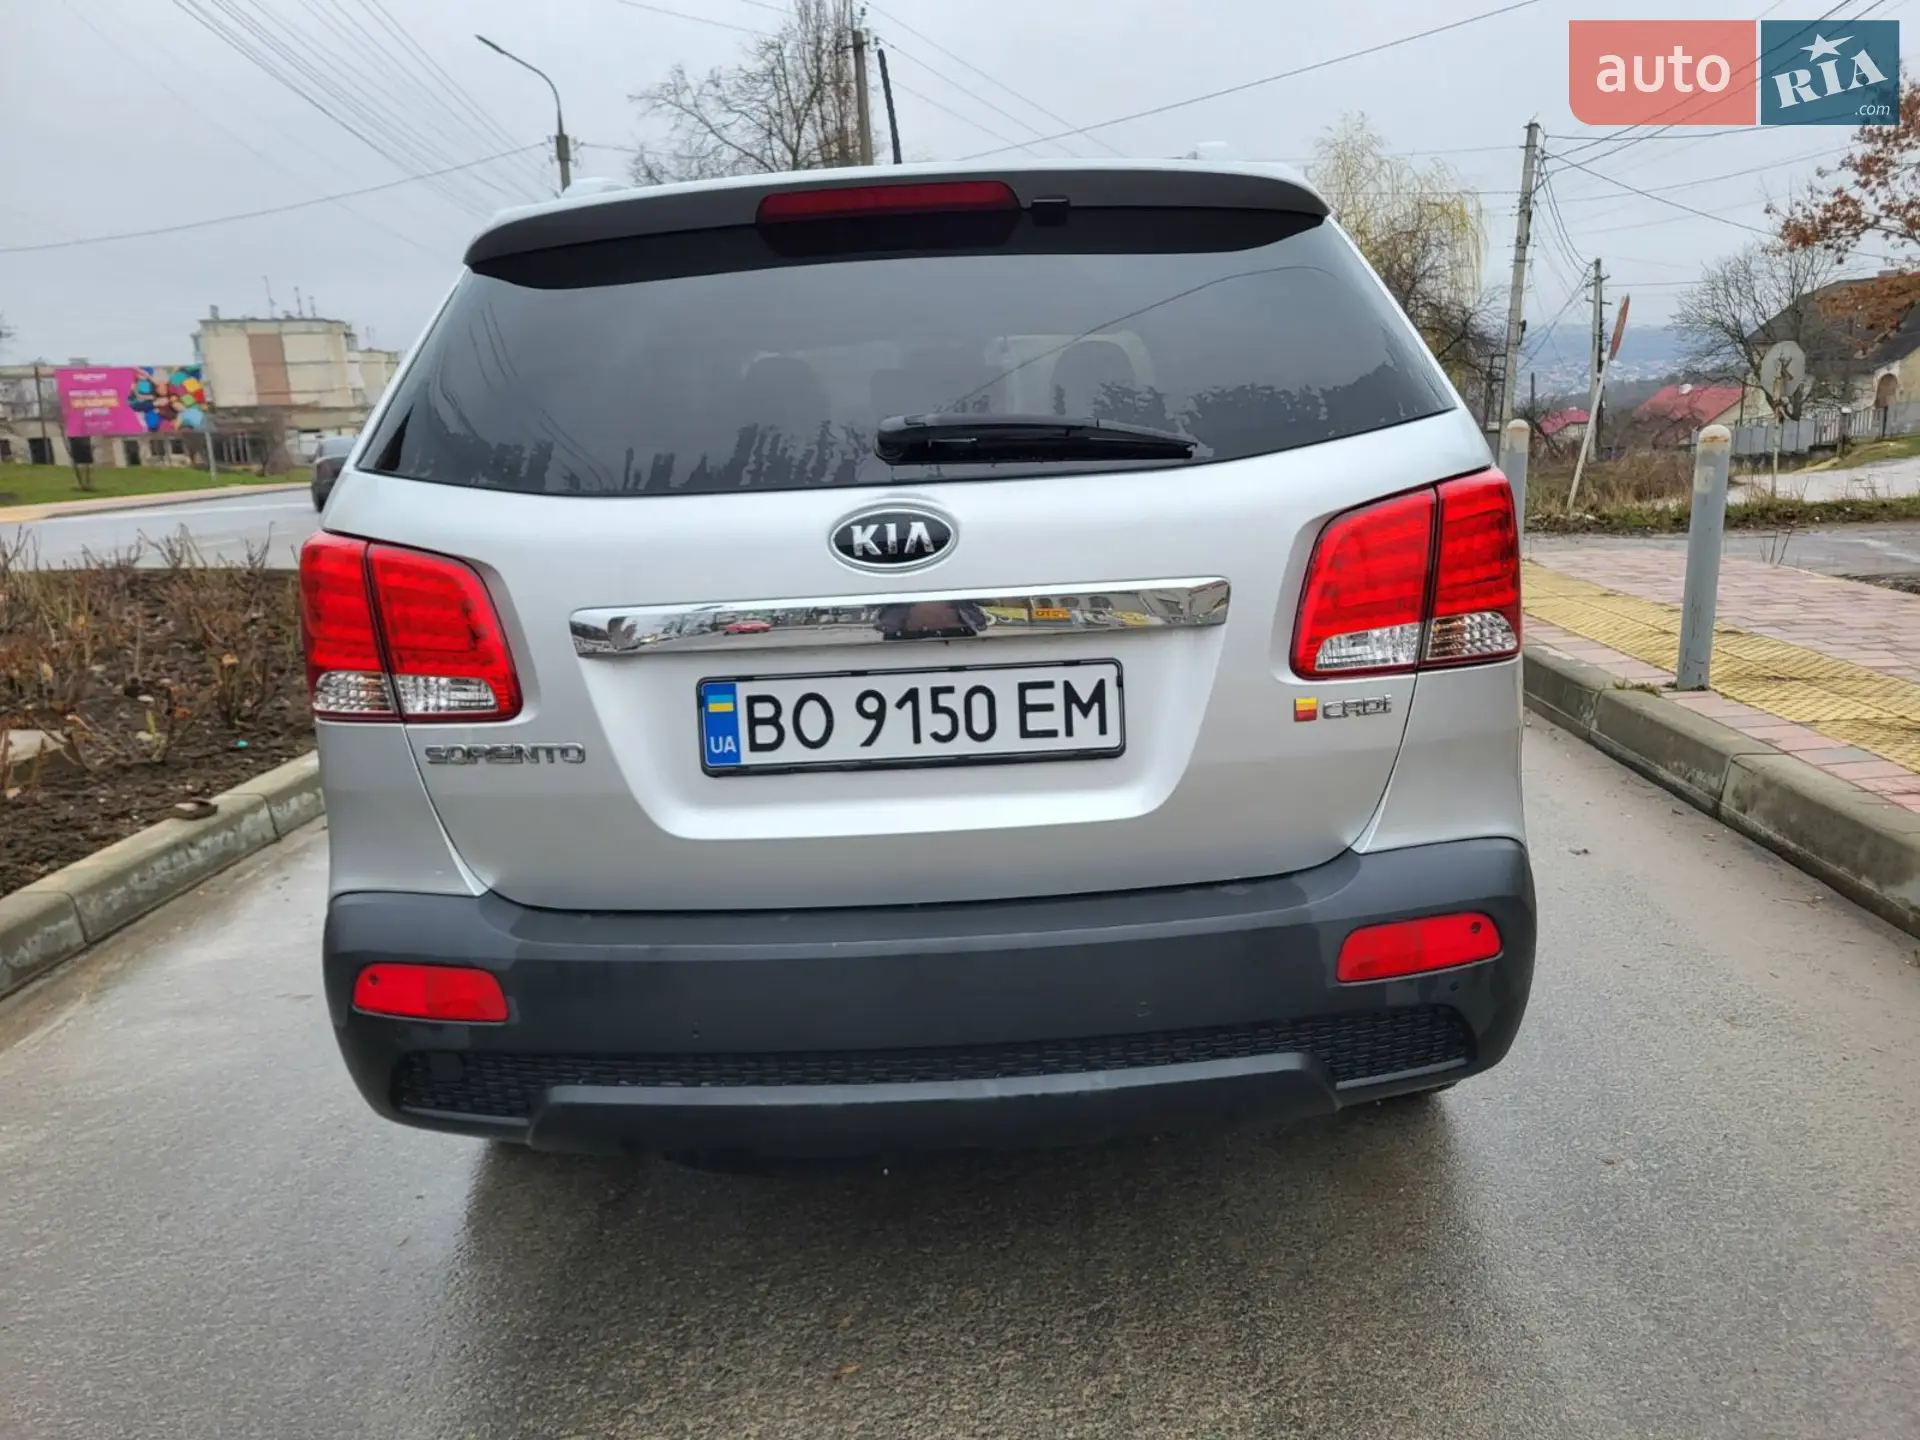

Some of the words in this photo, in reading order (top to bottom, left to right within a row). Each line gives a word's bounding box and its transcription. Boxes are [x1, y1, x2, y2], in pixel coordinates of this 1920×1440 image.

[850, 521, 935, 556] KIA
[746, 692, 834, 753] BO
[855, 685, 998, 748] 9150
[1017, 678, 1108, 739] EM
[424, 742, 587, 766] SORENTO
[709, 735, 738, 755] UA
